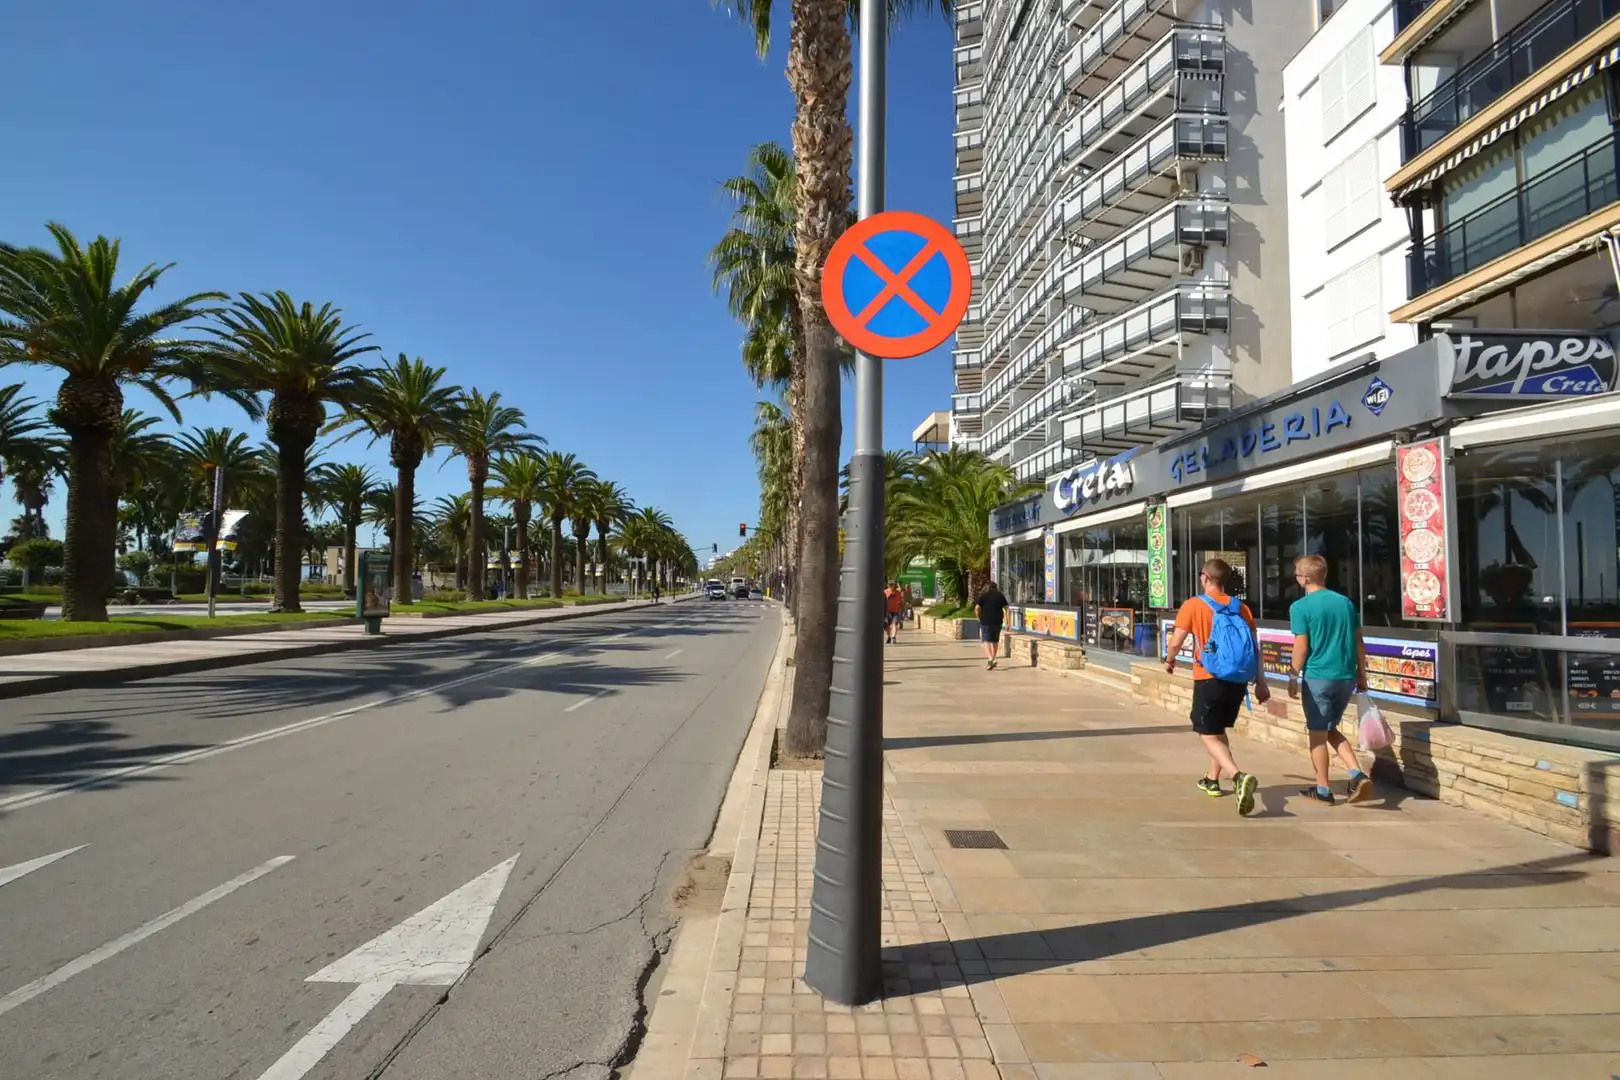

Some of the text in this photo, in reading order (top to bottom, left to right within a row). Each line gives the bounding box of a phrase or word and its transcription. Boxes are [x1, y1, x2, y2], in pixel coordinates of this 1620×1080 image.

[1453, 334, 1614, 394] tapes
[1541, 376, 1609, 393] Creta
[1169, 399, 1352, 484] GELADERIA
[1053, 459, 1136, 510] Creta
